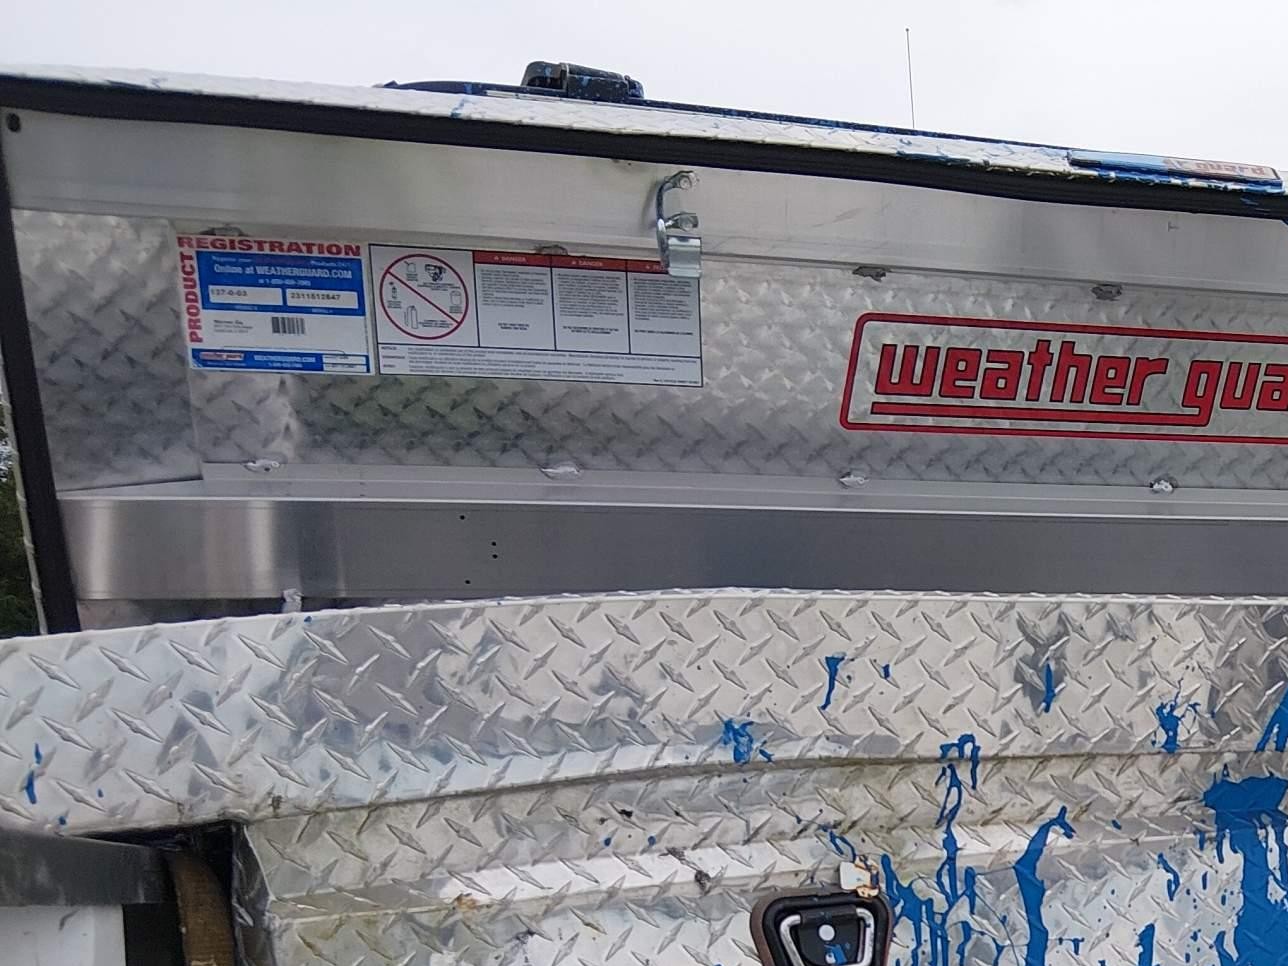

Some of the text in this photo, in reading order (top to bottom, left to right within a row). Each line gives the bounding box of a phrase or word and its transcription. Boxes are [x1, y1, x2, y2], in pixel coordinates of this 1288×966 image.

[177, 235, 362, 257] REGISTRATION
[179, 251, 203, 343] PRODUCT
[873, 338, 1170, 406] weather
